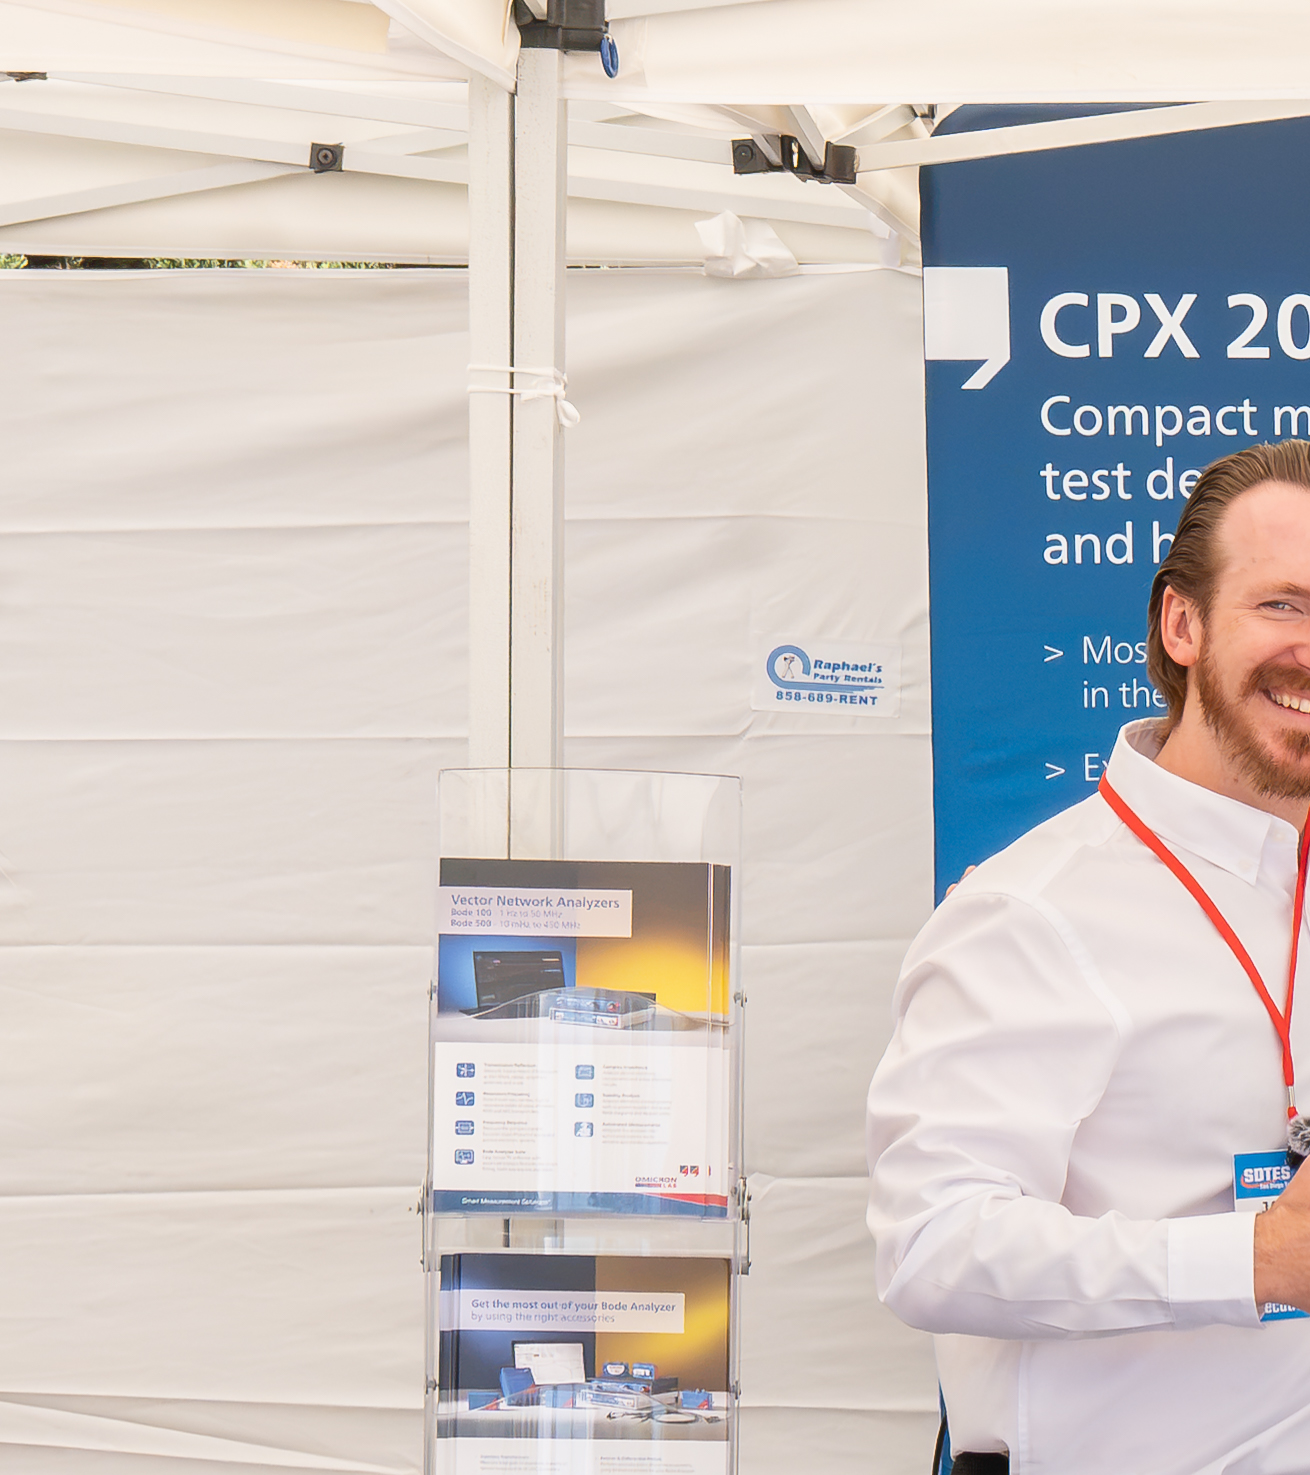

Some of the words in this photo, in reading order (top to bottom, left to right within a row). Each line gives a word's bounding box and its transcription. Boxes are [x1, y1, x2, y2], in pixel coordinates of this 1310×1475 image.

[1039, 291, 1200, 360] CPX
[1040, 395, 1257, 446] Compact
[1040, 461, 1132, 501] test
[1043, 521, 1135, 563] and
[1082, 636, 1148, 664] Mos
[814, 660, 882, 673] Raphael's
[813, 673, 840, 683] Party
[844, 675, 882, 683] Rentals
[776, 691, 878, 705] 858-689-RENT
[1082, 681, 1110, 708] in
[1118, 678, 1166, 708] the
[451, 894, 493, 906] Vector
[497, 895, 553, 907] Network
[556, 896, 620, 910] Analyzers
[1243, 1166, 1291, 1183] SDTES
[472, 1300, 489, 1309] Get
[492, 1300, 510, 1309] the
[512, 1301, 538, 1309] most
[541, 1301, 559, 1310] out
[575, 1302, 598, 1312] your
[601, 1302, 628, 1311] Bode
[631, 1303, 676, 1313] Analyzer
[471, 1312, 483, 1322] by
[486, 1313, 512, 1323] using
[515, 1312, 532, 1322] the
